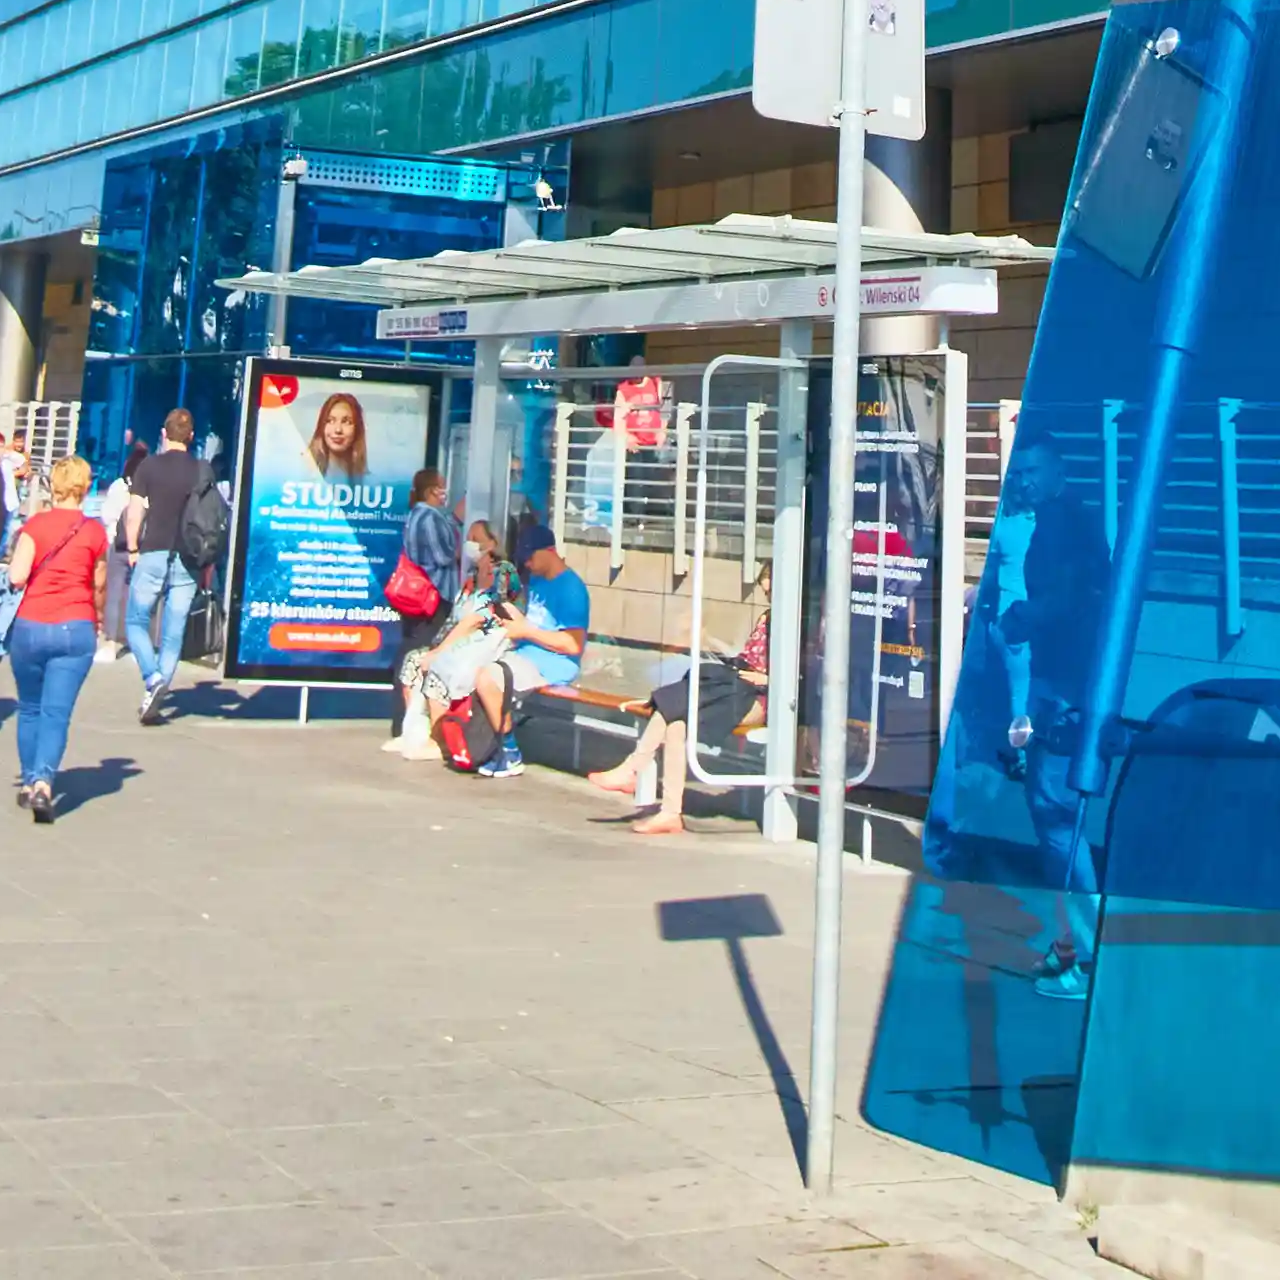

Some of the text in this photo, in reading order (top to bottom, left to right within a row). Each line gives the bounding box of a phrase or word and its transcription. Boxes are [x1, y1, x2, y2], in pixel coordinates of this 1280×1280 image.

[908, 286, 920, 303] 04
[339, 368, 363, 379] ams
[280, 481, 394, 508] STUDIUJ
[249, 601, 269, 618] 25
